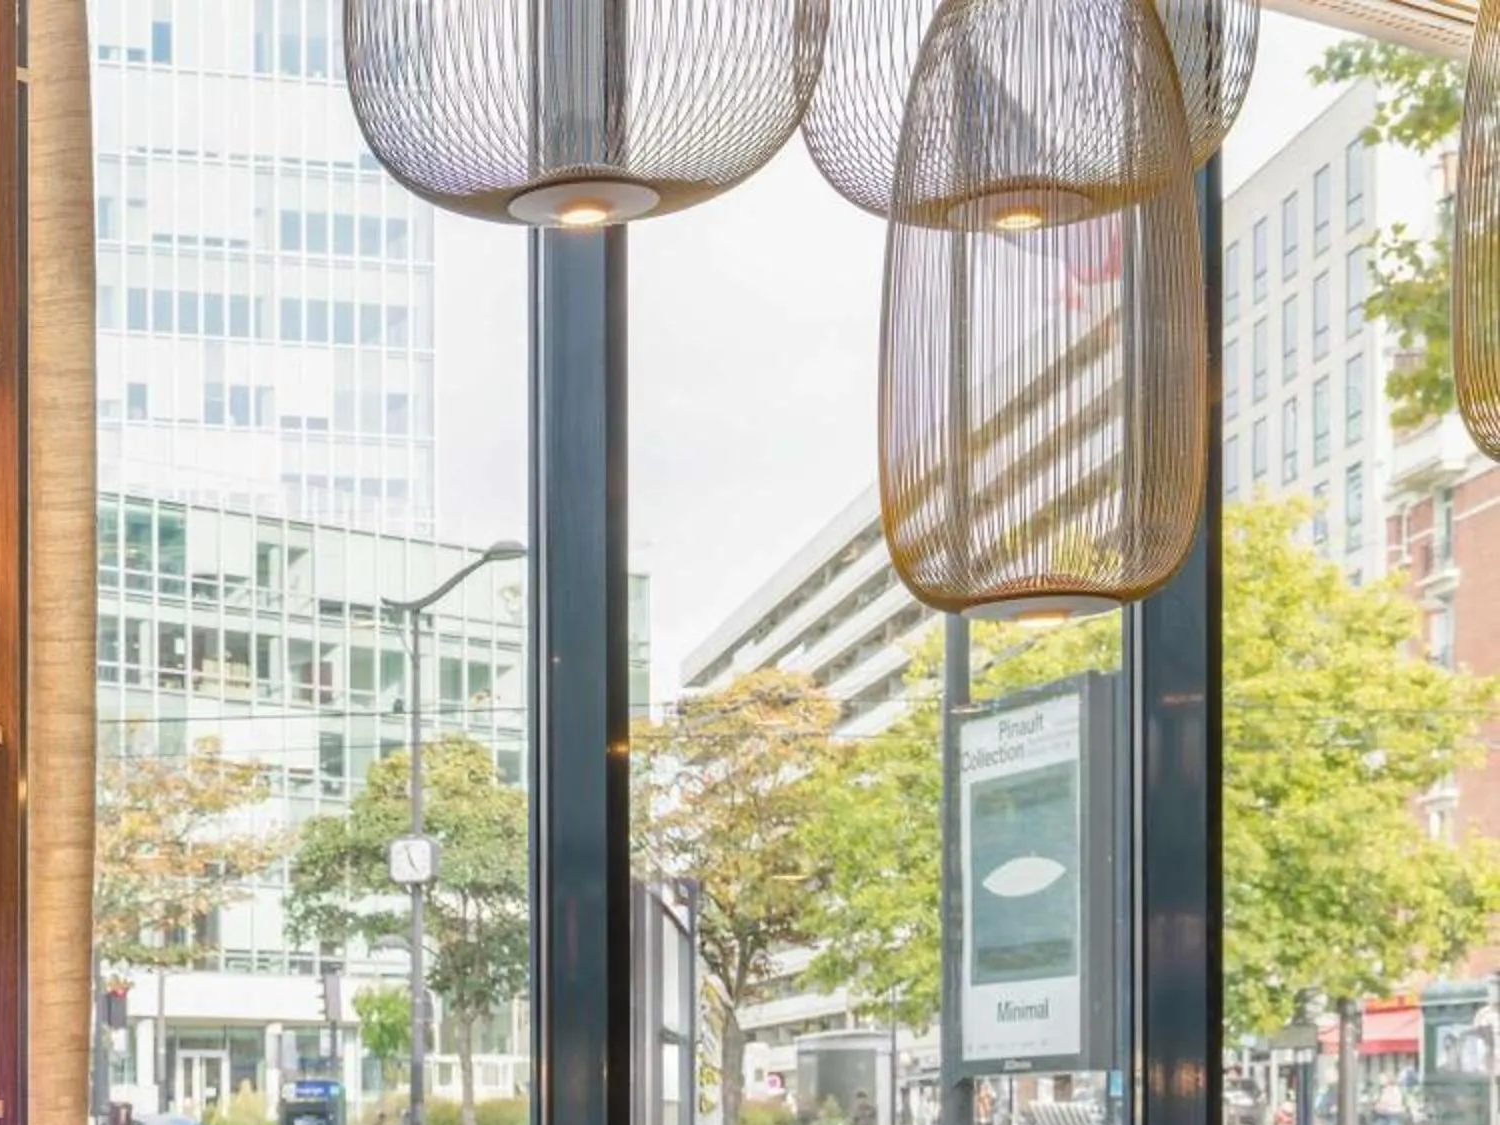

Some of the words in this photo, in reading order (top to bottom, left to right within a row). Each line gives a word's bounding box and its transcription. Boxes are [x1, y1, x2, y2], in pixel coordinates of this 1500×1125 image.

[998, 709, 1044, 740] Pinault
[961, 741, 1025, 772] Collection
[996, 998, 1050, 1023] Minimal
